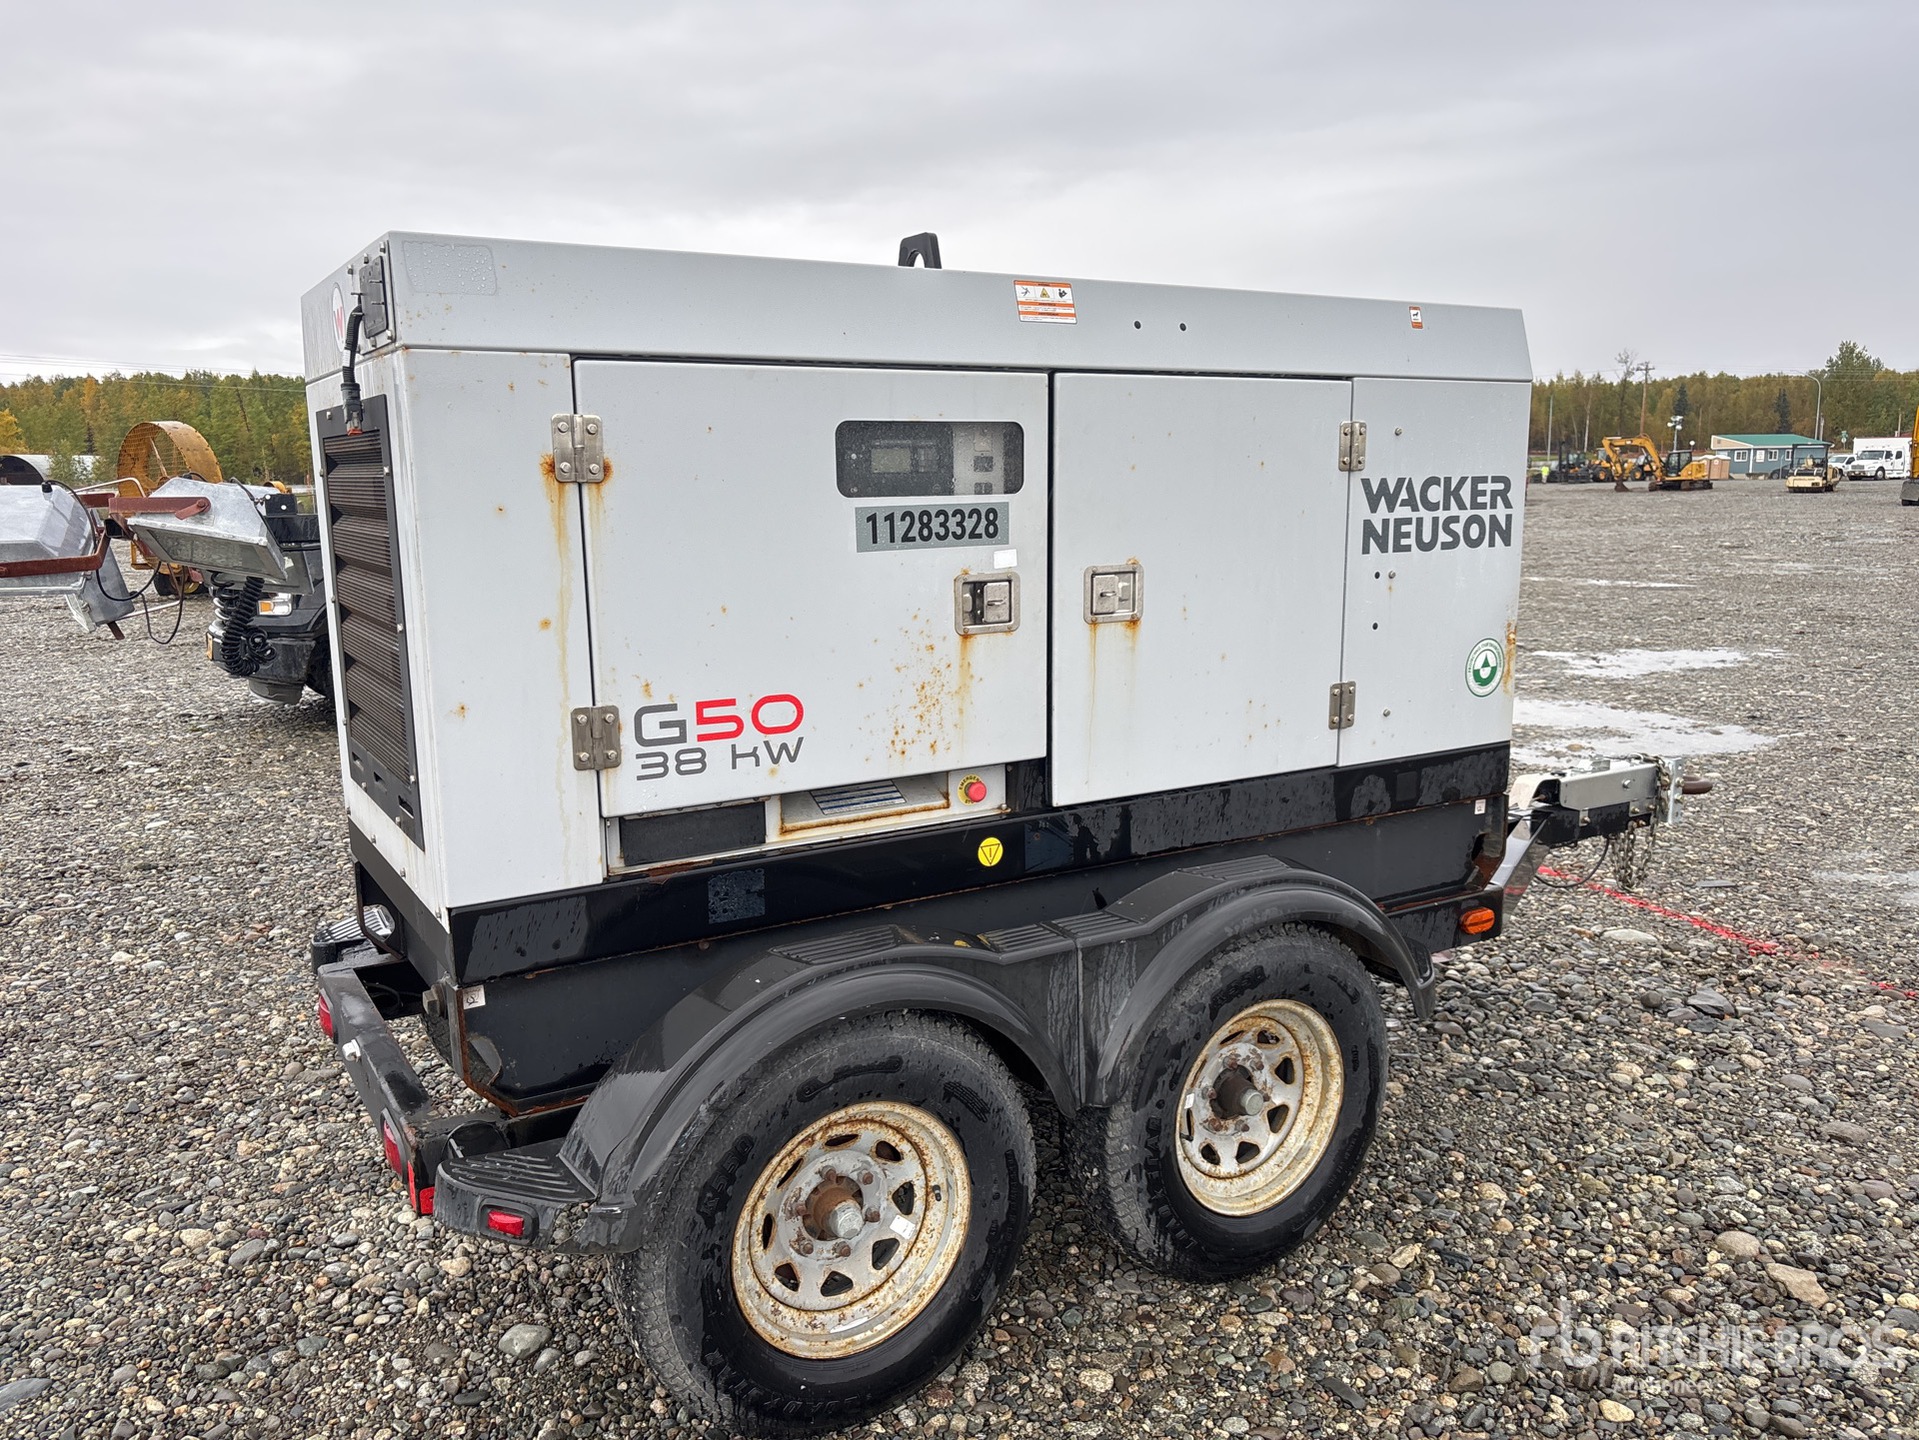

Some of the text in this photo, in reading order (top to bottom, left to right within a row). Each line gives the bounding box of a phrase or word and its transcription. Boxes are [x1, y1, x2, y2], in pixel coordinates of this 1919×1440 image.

[1360, 475, 1513, 514] WACKER
[866, 507, 999, 544] 11283328
[1361, 513, 1513, 555] NEUSON
[634, 693, 804, 747] G50
[635, 747, 707, 781] 38
